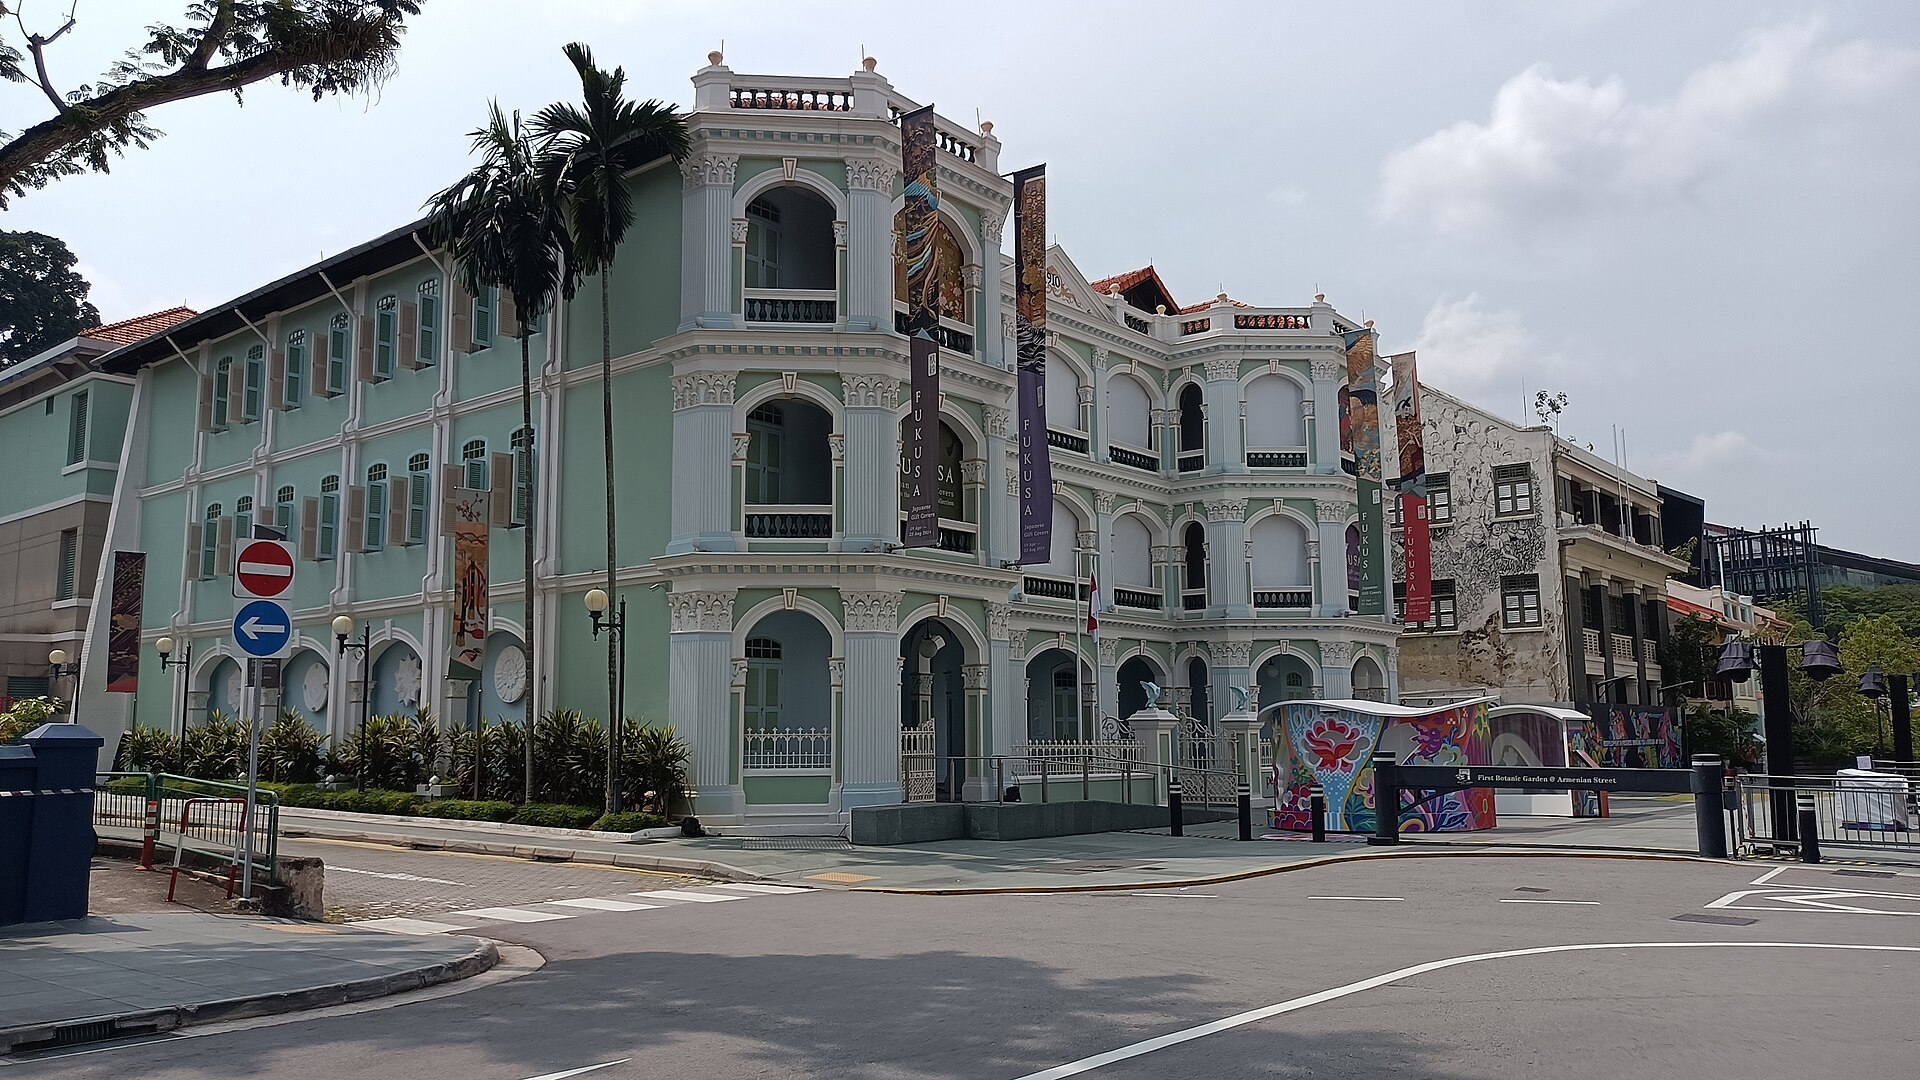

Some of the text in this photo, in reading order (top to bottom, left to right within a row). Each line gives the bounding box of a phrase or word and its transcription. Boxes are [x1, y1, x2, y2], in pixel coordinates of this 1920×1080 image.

[1046, 272, 1061, 288] 910
[912, 390, 922, 497] FUKUSA
[1023, 419, 1032, 516] FUKUSA
[911, 504, 931, 513] Japanese
[937, 487, 955, 497] overs
[1361, 512, 1369, 581] FUKUSA
[1407, 526, 1416, 592] FUKUSA
[1477, 774, 1494, 782] First
[1495, 774, 1521, 782] Botanic
[1522, 775, 1548, 783] Garden
[1593, 776, 1617, 784] Street
